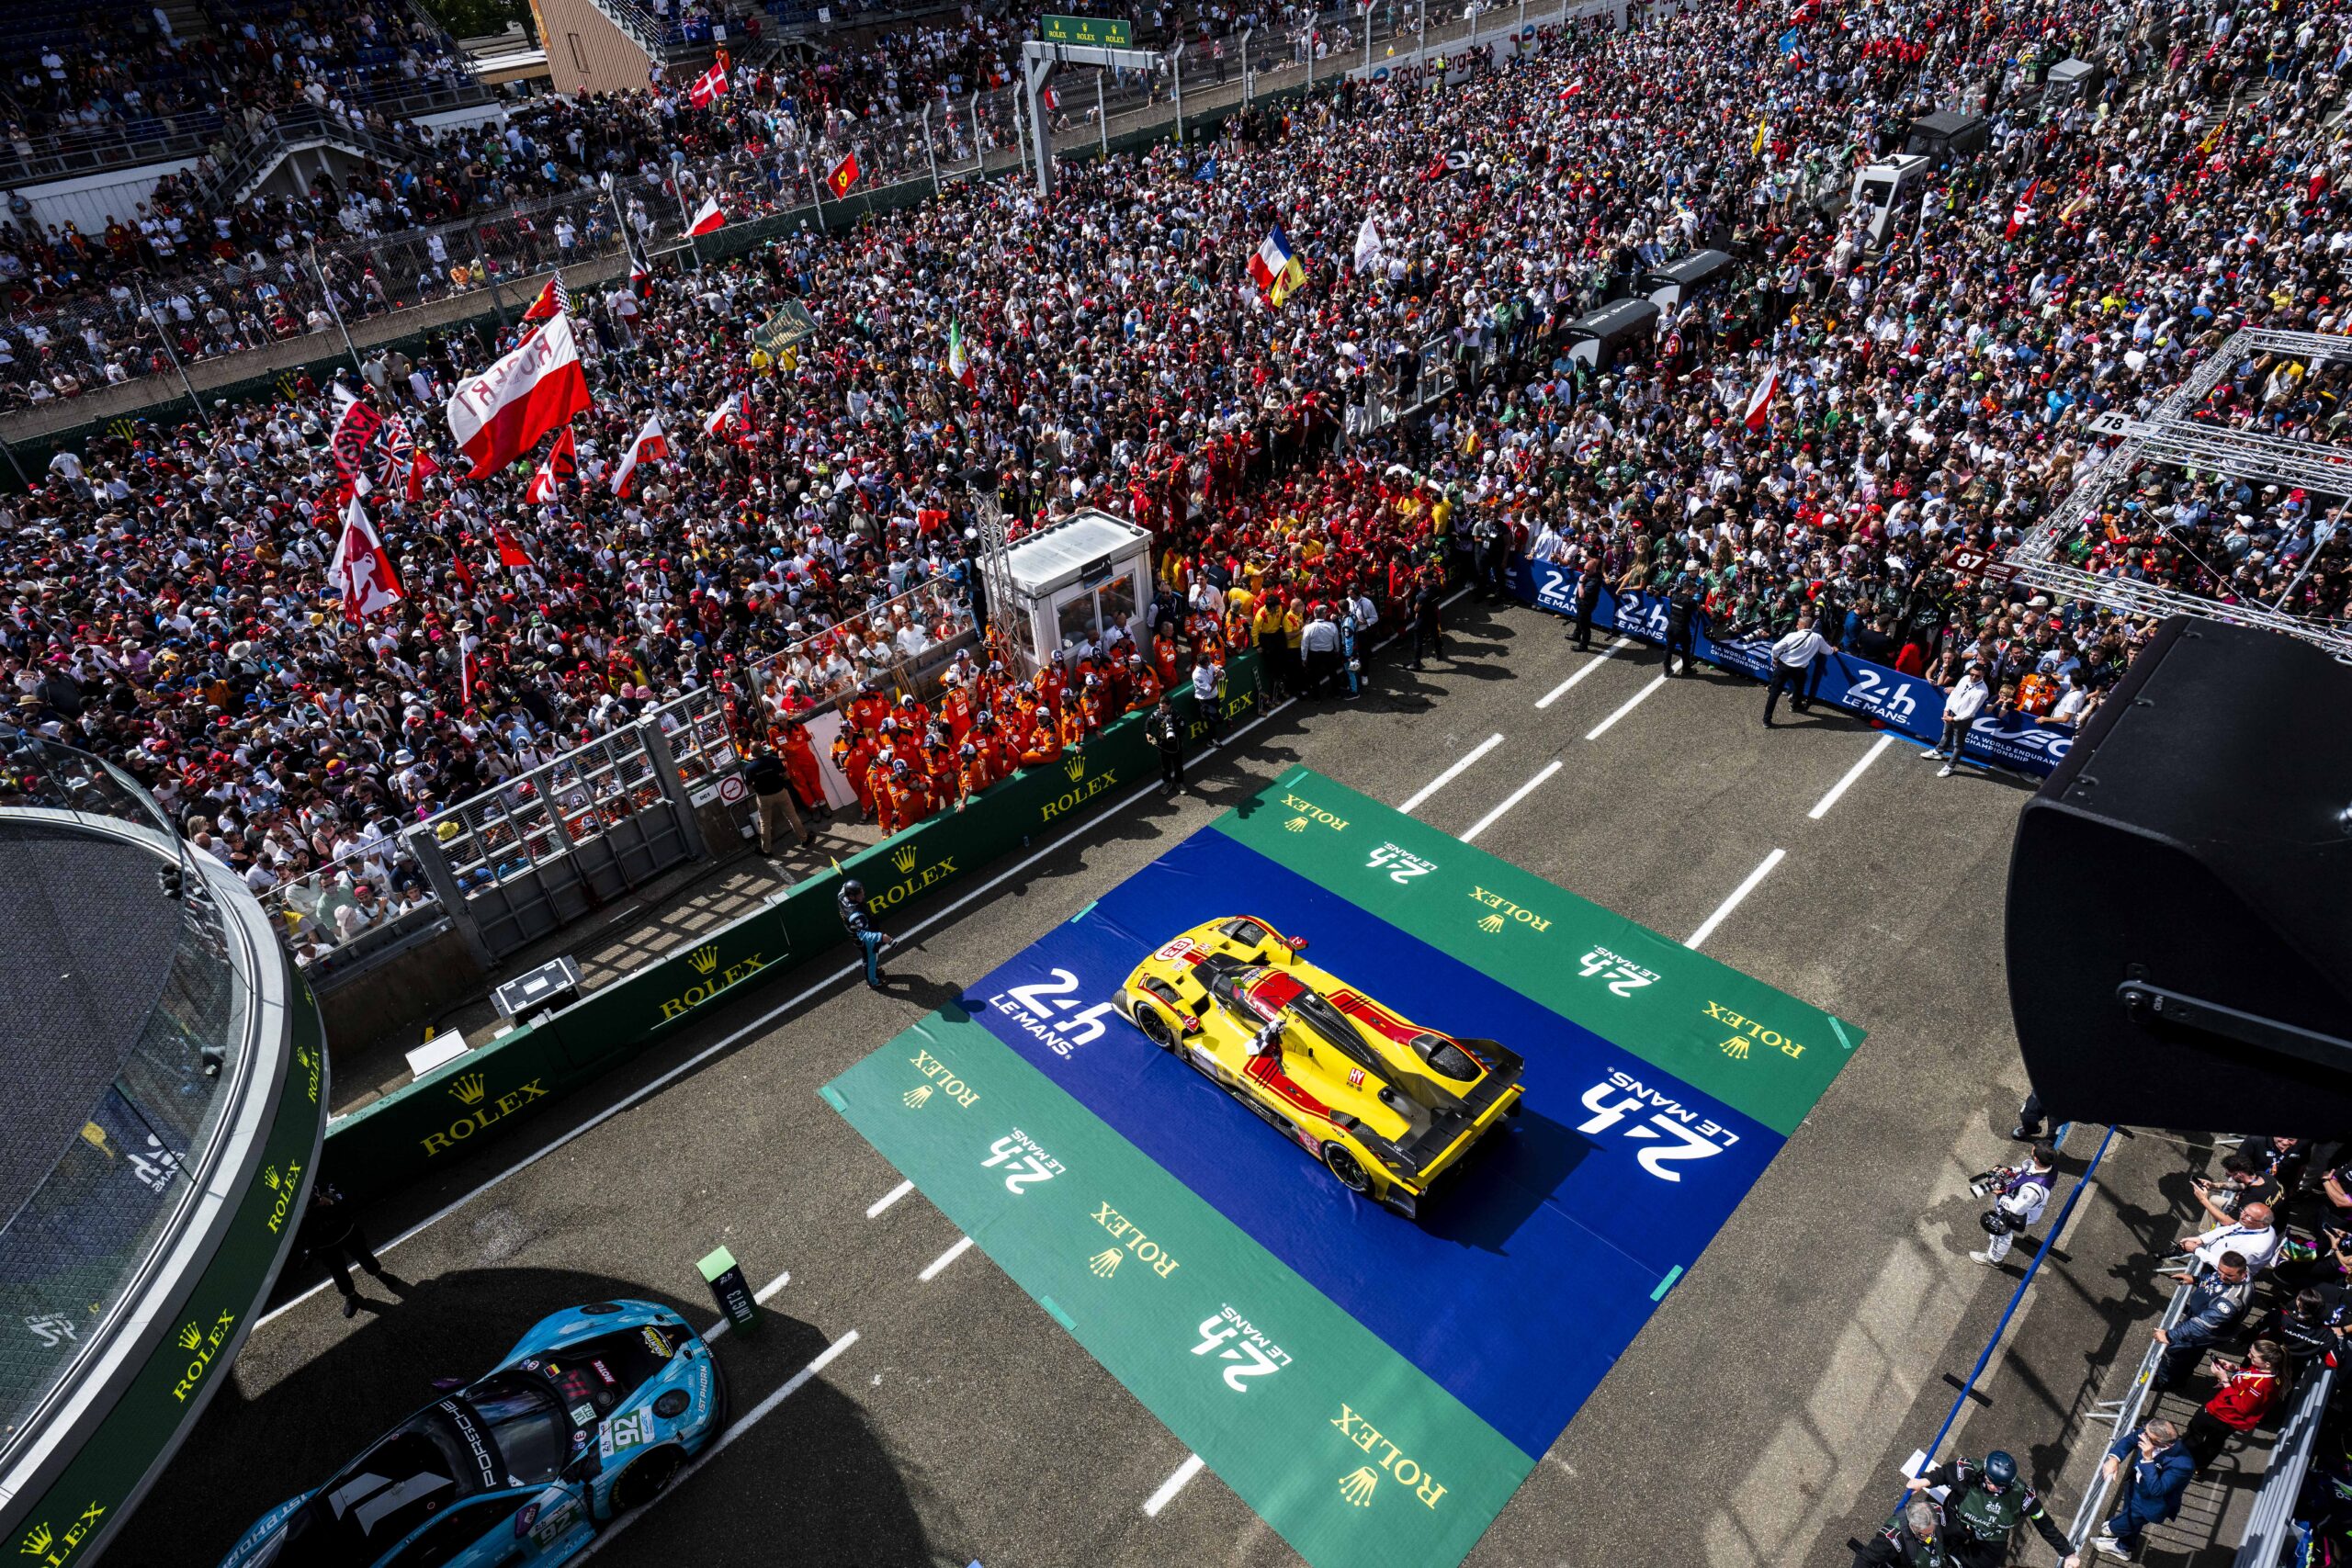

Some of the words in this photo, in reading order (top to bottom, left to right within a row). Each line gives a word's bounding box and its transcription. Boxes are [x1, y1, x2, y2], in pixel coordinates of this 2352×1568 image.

[1048, 30, 1068, 39] ROLEX
[1076, 32, 1096, 41] ROLEX
[1105, 35, 1125, 44] ROLEX
[1392, 52, 1470, 85] TotalEerg
[2101, 415, 2125, 431] 78
[1956, 552, 1984, 570] 87
[1537, 593, 1551, 606] LE
[1551, 598, 1579, 615] MAN
[1616, 593, 1669, 632] 24h
[1627, 622, 1668, 641] MANS
[1710, 649, 1760, 671] CHAMPIONSHIP
[1711, 644, 1722, 653] FIA
[1722, 648, 1747, 662] WORLD
[1747, 657, 1777, 672] ENDURA
[1848, 669, 1917, 716] 24h
[1841, 694, 1863, 710] LE
[1862, 700, 1908, 725] MANS
[1964, 738, 2030, 763] CHAMPIONSHIP
[1966, 731, 1980, 742] FIA
[1981, 737, 2012, 754] WORLD
[1040, 768, 1118, 823] ROLEX
[1281, 794, 1351, 831] ROLEX
[1365, 846, 1430, 885] 24h
[1385, 841, 1422, 864] MANS
[1416, 859, 1439, 872] LE
[866, 855, 959, 916] ROLEX
[1467, 886, 1553, 932] ROLEX
[1577, 952, 1653, 998] 24h
[1596, 946, 1642, 974] MANS
[1637, 968, 1662, 982] LE
[659, 952, 770, 1021] ROLEX
[1007, 967, 1114, 1046] 24h
[989, 993, 1021, 1016] LE
[1012, 1011, 1075, 1056] MANS
[1702, 1000, 1806, 1059] ROLEX
[910, 1049, 981, 1109] ROLEX
[1349, 1067, 1365, 1086] HY
[1609, 1071, 1700, 1124] MANS
[420, 1077, 549, 1157] ROLEX
[1576, 1081, 1724, 1183] 24h
[1694, 1119, 1741, 1147] LE
[1011, 1127, 1051, 1162] MANS
[980, 1135, 1055, 1195] 24h
[1044, 1157, 1067, 1175] LE
[266, 1159, 301, 1234] ROLEX
[1090, 1201, 1181, 1279] ROLEX
[726, 1290, 753, 1324] LMGT3
[1220, 1306, 1272, 1348] MANS
[2284, 1328, 2325, 1346] MANTHEY
[173, 1308, 235, 1404] ROLEX
[1190, 1314, 1280, 1393] 24h
[1266, 1345, 1294, 1367] LE
[594, 1359, 613, 1382] MOTUL
[699, 1365, 707, 1398] PHORM
[582, 1404, 594, 1419] GT3
[698, 1399, 707, 1413] 1ST
[439, 1400, 497, 1487] PORSCHE
[615, 1416, 640, 1447] 92
[1330, 1403, 1449, 1509] ROLEX
[40, 1500, 107, 1568] LEX
[540, 1511, 571, 1544] 92
